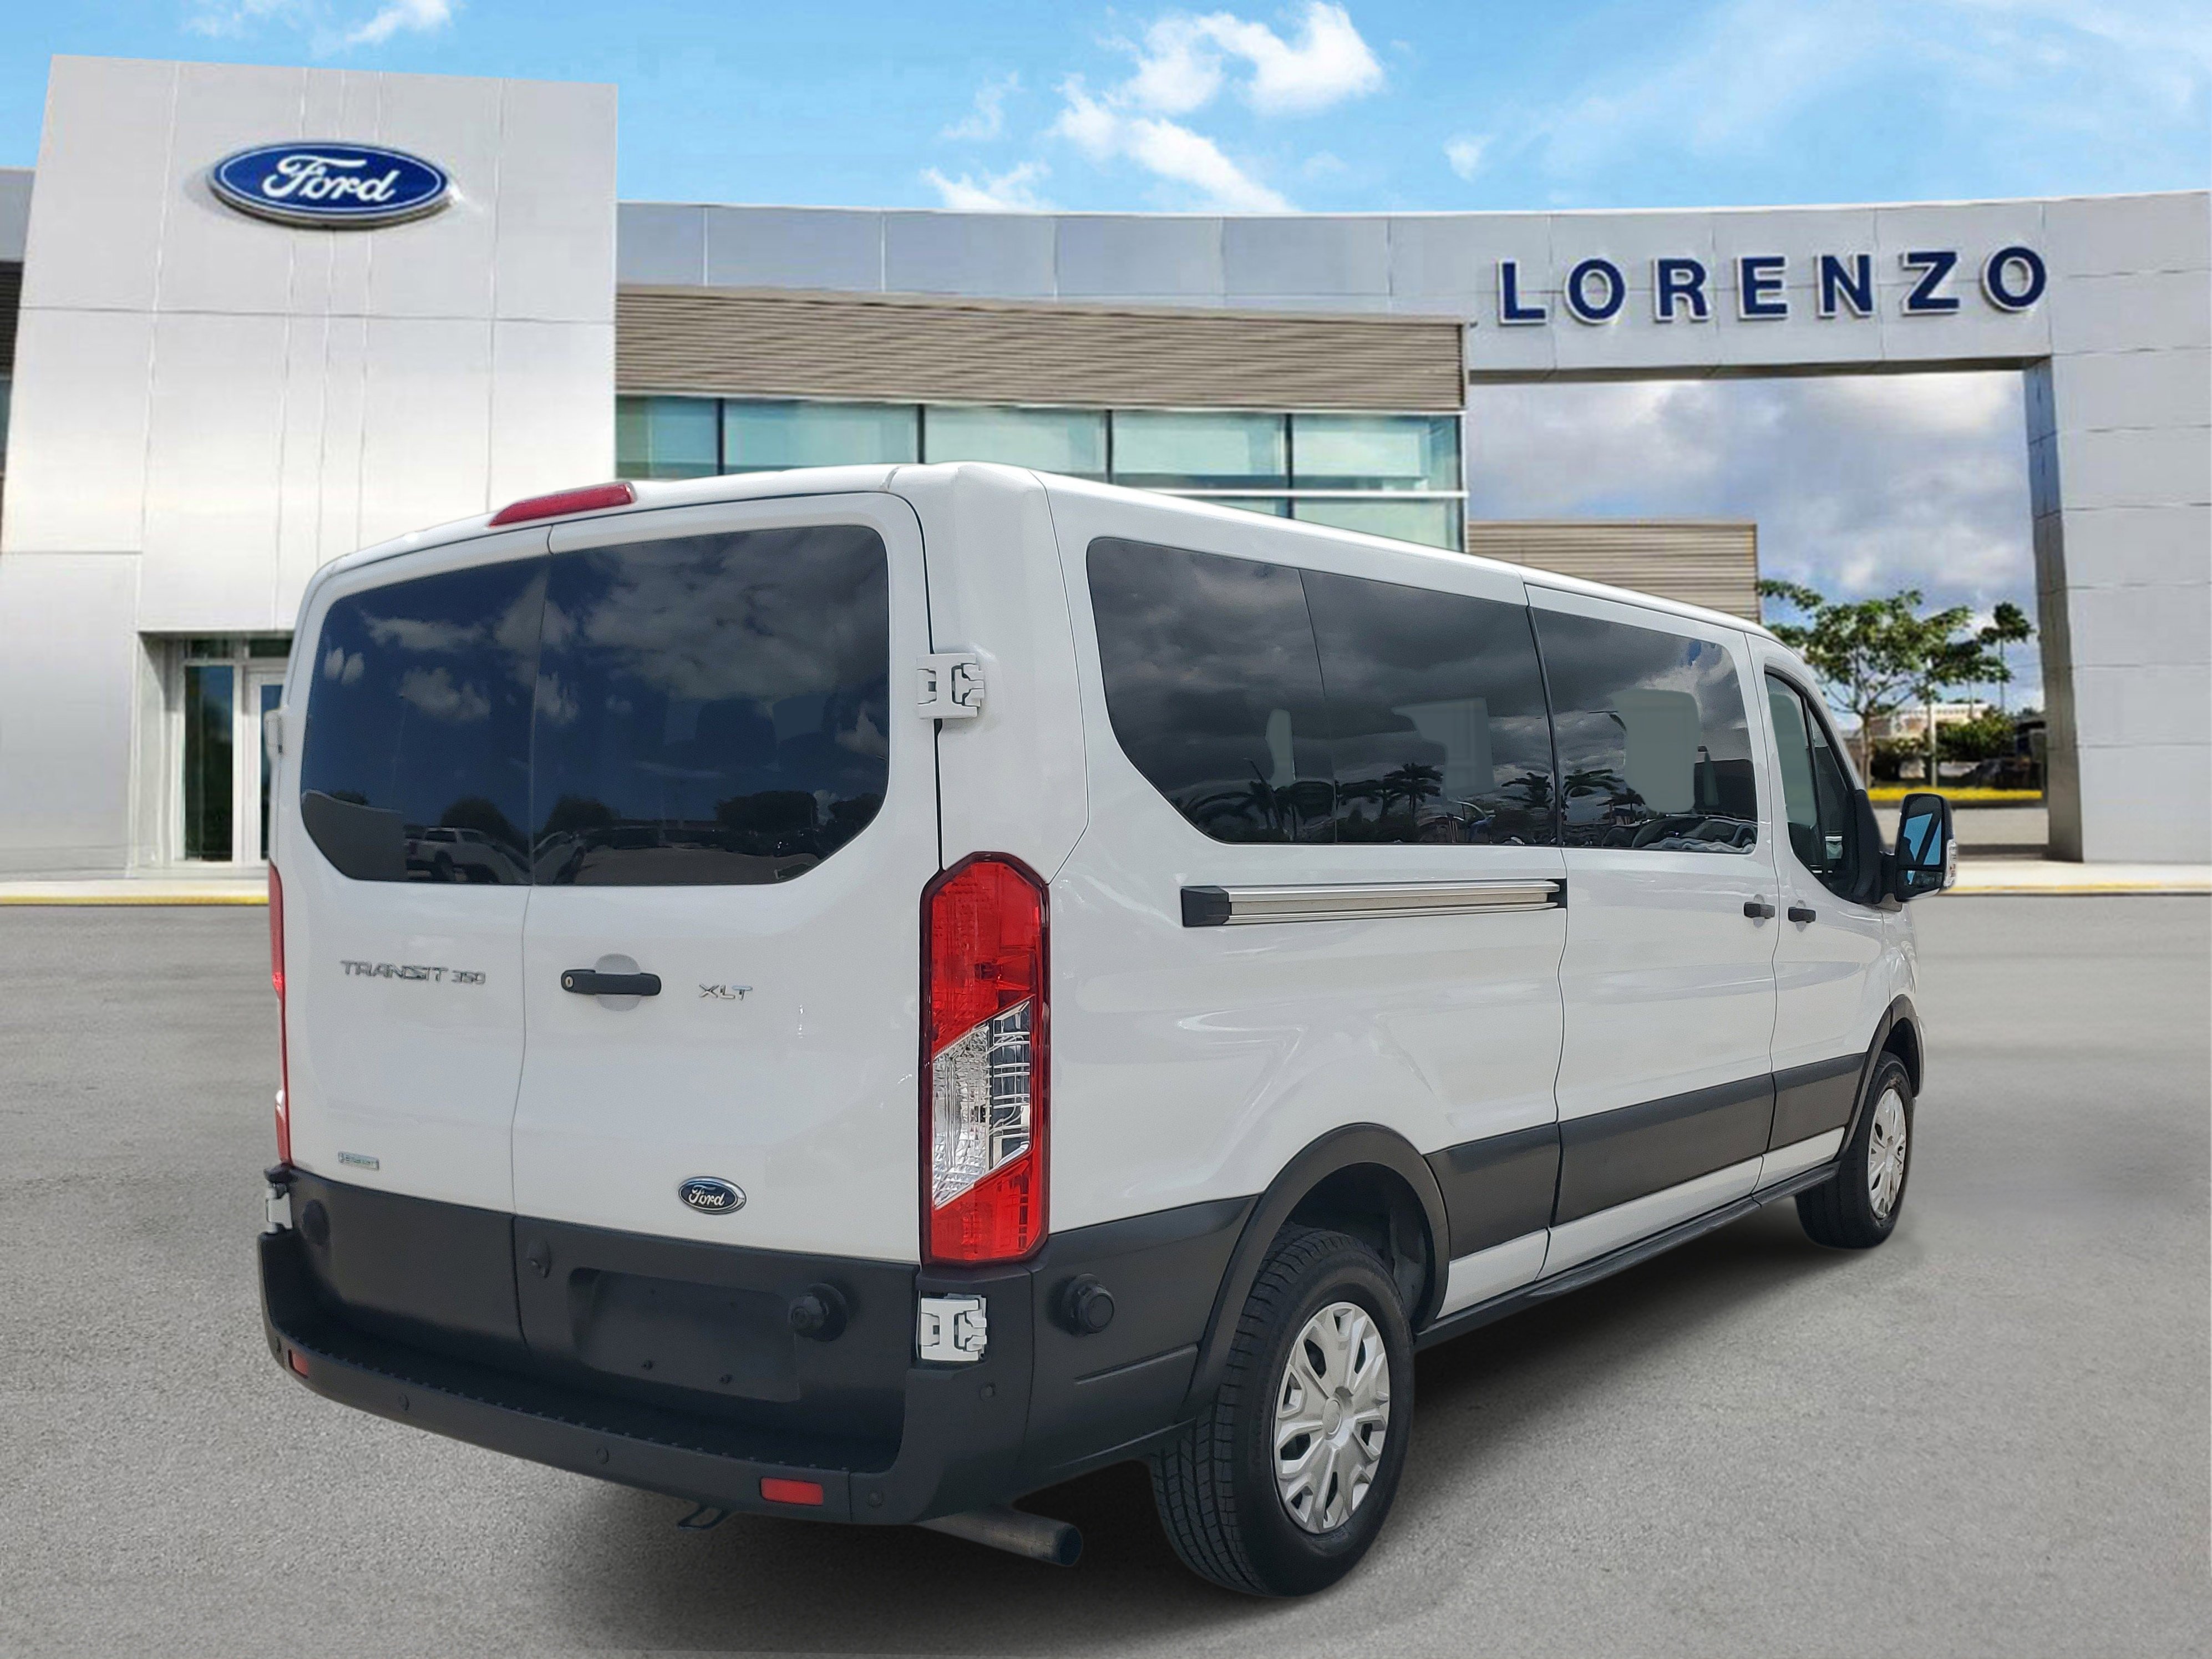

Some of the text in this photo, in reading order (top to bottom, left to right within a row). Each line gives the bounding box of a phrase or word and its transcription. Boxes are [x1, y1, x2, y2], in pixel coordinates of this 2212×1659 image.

[262, 155, 400, 202] Ford
[1498, 245, 2047, 325] LORENZO
[340, 960, 448, 982] TRANSIT
[699, 985, 753, 1001] XLT
[688, 1185, 726, 1206] Ford
